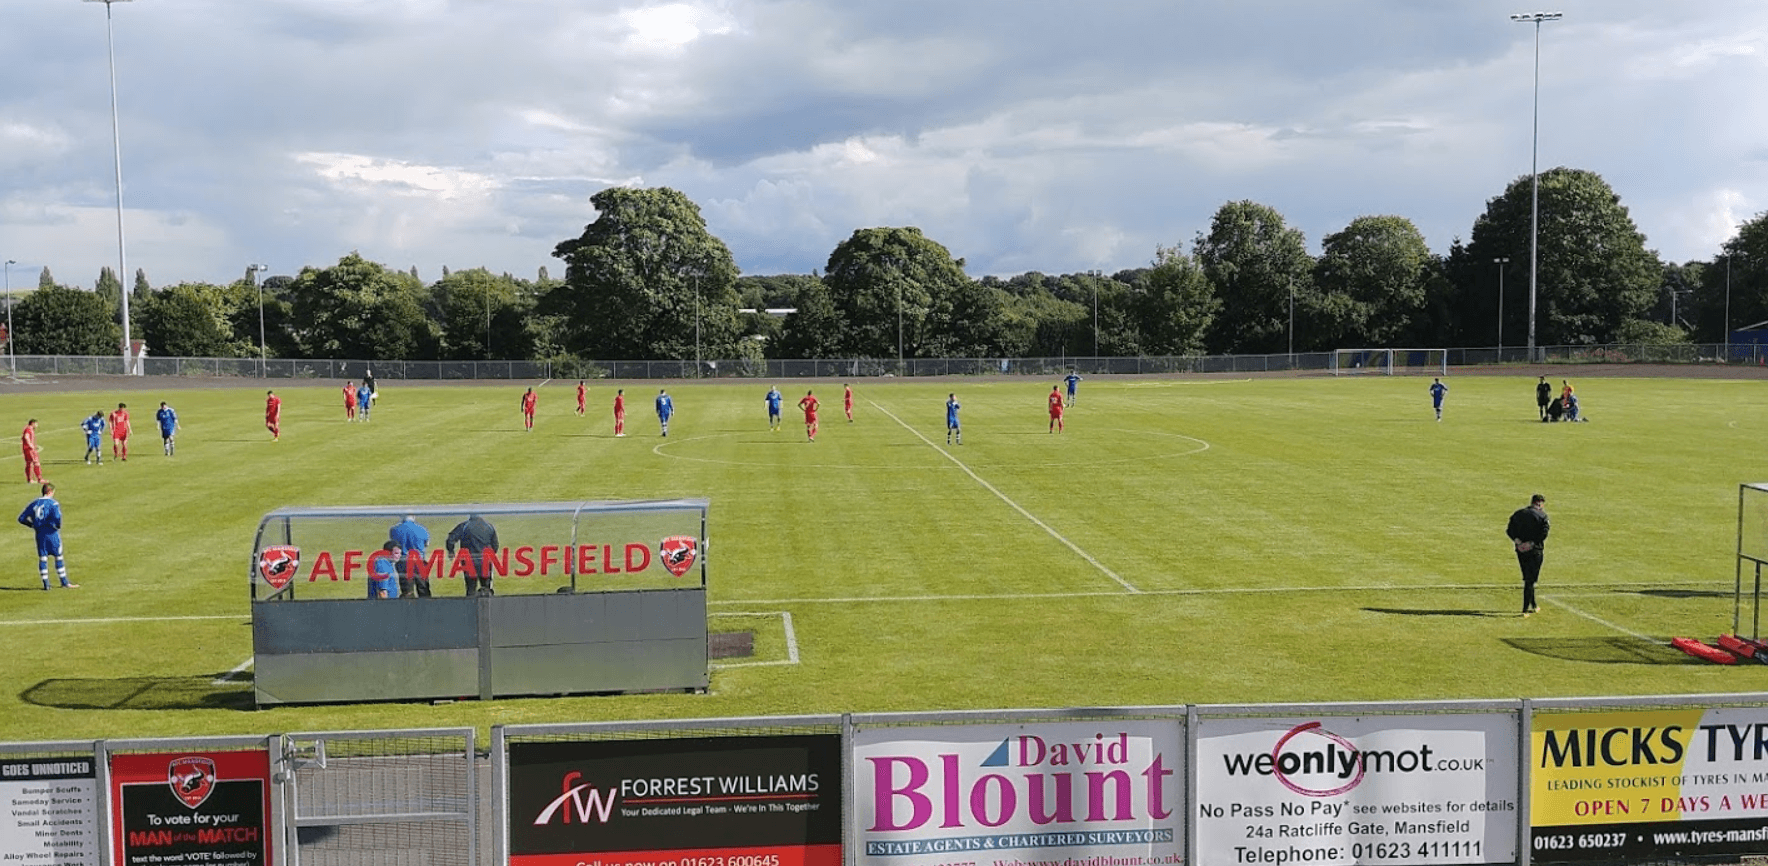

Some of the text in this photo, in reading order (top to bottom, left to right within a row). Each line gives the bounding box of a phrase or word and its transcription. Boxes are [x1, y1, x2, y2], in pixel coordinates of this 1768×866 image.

[308, 543, 651, 582] AFC MANSFIELD
[1016, 733, 1128, 767] David
[1541, 723, 1768, 768] MICKS TYR
[2, 762, 89, 776] GOES UNNOTICED
[22, 786, 81, 795] Bumper Scuffs
[621, 774, 819, 797] FORREST WILLIAMS
[1548, 779, 1602, 791] LEADING
[1607, 777, 1666, 788] STOCKIST
[1671, 776, 1687, 786] OF
[1693, 773, 1728, 785] TYRES
[1733, 773, 1747, 783] IN
[865, 752, 1173, 832] Blount
[12, 798, 49, 806] Sameday
[621, 808, 639, 817] Your
[641, 807, 681, 816] Dedicated
[683, 805, 703, 816] Legal
[705, 804, 727, 814] Team
[733, 804, 757, 813] We're
[758, 803, 766, 812] In
[768, 803, 784, 812] This
[785, 802, 820, 813] Together
[1200, 803, 1224, 818] No
[1231, 803, 1274, 818] Pass
[1280, 802, 1305, 817] No
[1353, 805, 1375, 814] see
[1381, 802, 1441, 814] websites
[1446, 801, 1466, 813] for
[1469, 800, 1514, 812] details
[1575, 800, 1629, 816] OPEN
[1641, 799, 1650, 813] 7
[1661, 796, 1709, 813] DAYS
[1718, 795, 1731, 811] A
[147, 812, 239, 826] To vote for your
[130, 830, 172, 846] MAN
[198, 827, 257, 844] MATCH
[1246, 820, 1470, 838] 24a Ratcliffe Gate, Mansfield
[44, 840, 84, 848] Motability
[868, 830, 1172, 855] ESTATE AGENTS & CHARTERED SURVEYORS
[1534, 836, 1573, 850] 01623
[1578, 833, 1626, 847] 650237
[54, 850, 84, 858] Repairs
[132, 855, 148, 863] text
[149, 854, 161, 862] the
[163, 853, 183, 861] word
[213, 851, 246, 860] followed
[247, 851, 257, 860] by
[681, 857, 724, 866] 01623
[728, 854, 779, 866] 600645
[1234, 841, 1481, 864] Telephone: 01623 411111
